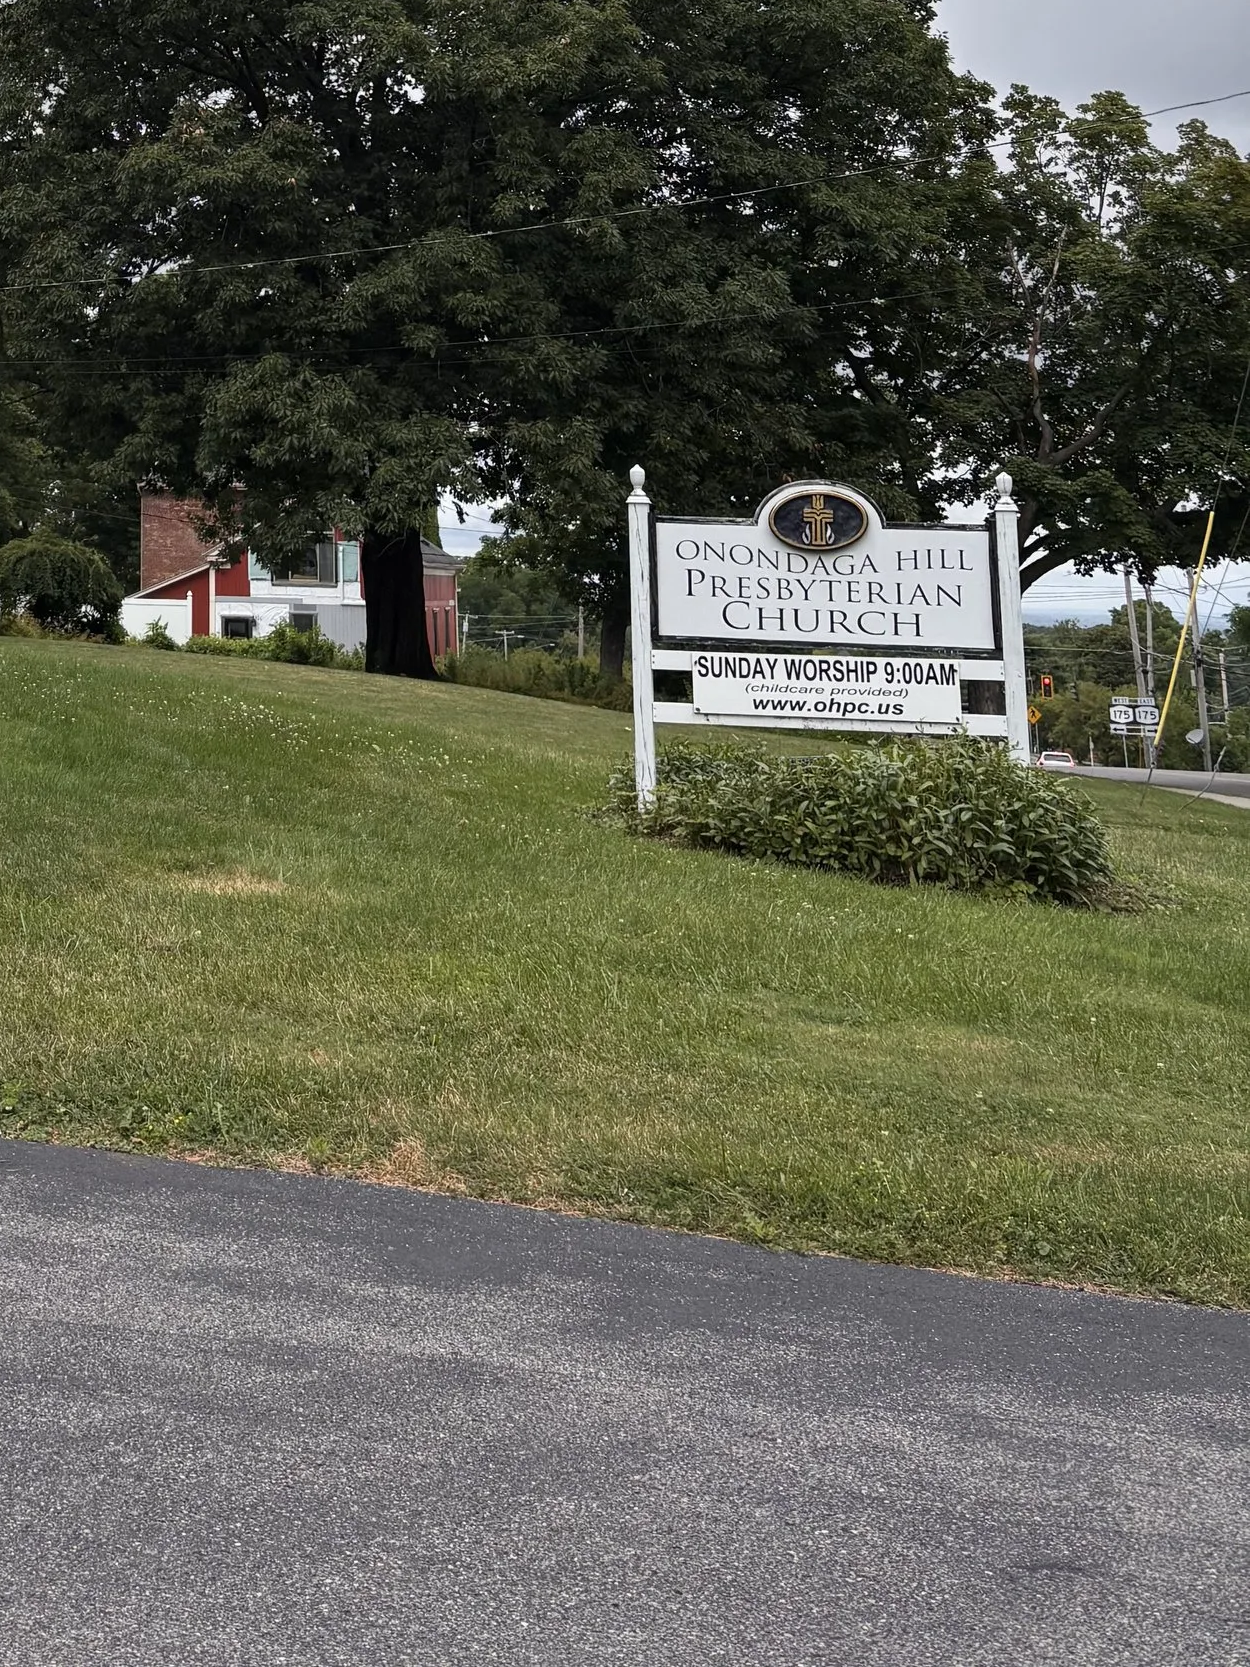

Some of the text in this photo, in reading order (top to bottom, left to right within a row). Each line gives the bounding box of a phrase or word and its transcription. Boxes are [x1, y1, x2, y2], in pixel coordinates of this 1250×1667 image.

[675, 539, 974, 576] ONONDAGA HILL
[685, 568, 963, 607] PRESBYTERIAN
[722, 600, 924, 637] CHURCH
[697, 655, 956, 686] SUNDAY WORSHIP 9:00AM
[745, 683, 909, 699] (childcare provided)
[752, 697, 904, 717] www.ohpc.us
[1113, 710, 1130, 719] 175
[1137, 710, 1157, 720] 175
